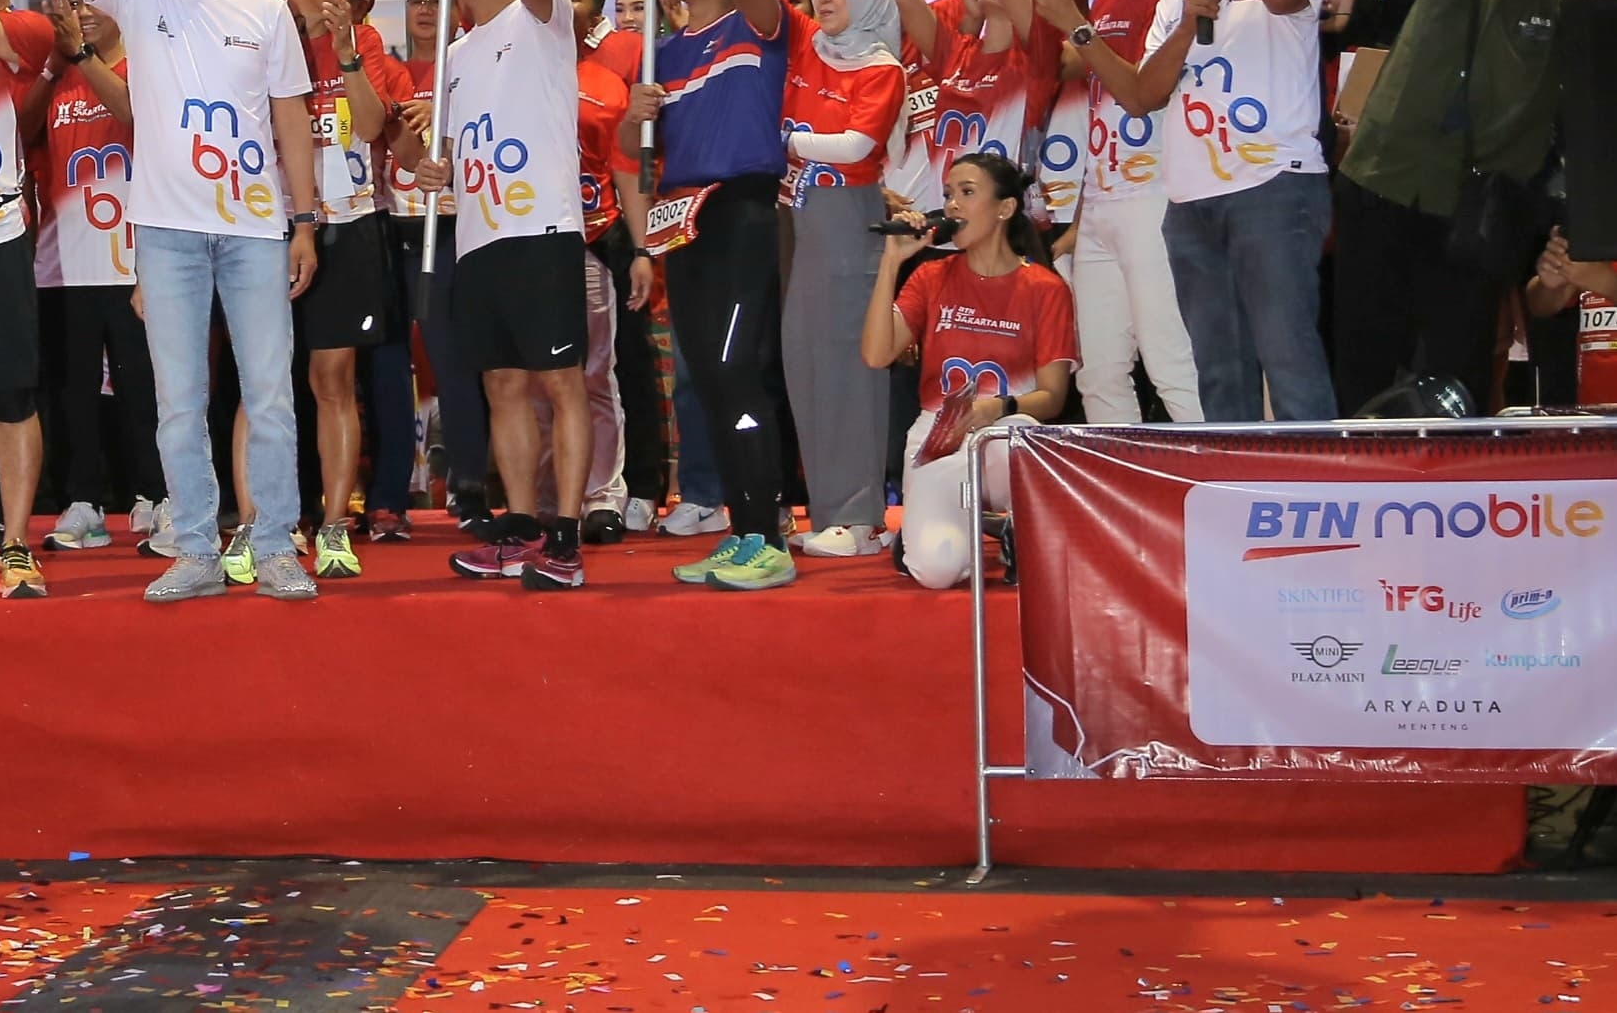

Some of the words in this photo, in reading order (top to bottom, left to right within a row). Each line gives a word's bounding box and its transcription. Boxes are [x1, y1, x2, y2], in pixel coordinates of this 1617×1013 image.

[340, 119, 348, 135] 10K
[649, 200, 688, 229] 29002
[954, 315, 998, 328] JAKARTA
[999, 320, 1021, 331] RUN
[1245, 500, 1360, 539] BTN
[1374, 493, 1605, 539] mobile
[1277, 586, 1365, 604] SKINTIFIC
[1448, 600, 1482, 623] Life
[1314, 647, 1340, 656] MINI
[1381, 643, 1462, 675] League
[1485, 647, 1581, 671] kumparan
[1291, 672, 1332, 683] PLAZA
[1334, 672, 1366, 683] MINI
[1364, 700, 1502, 714] ARYADUTA
[1397, 723, 1469, 731] MENTENG
